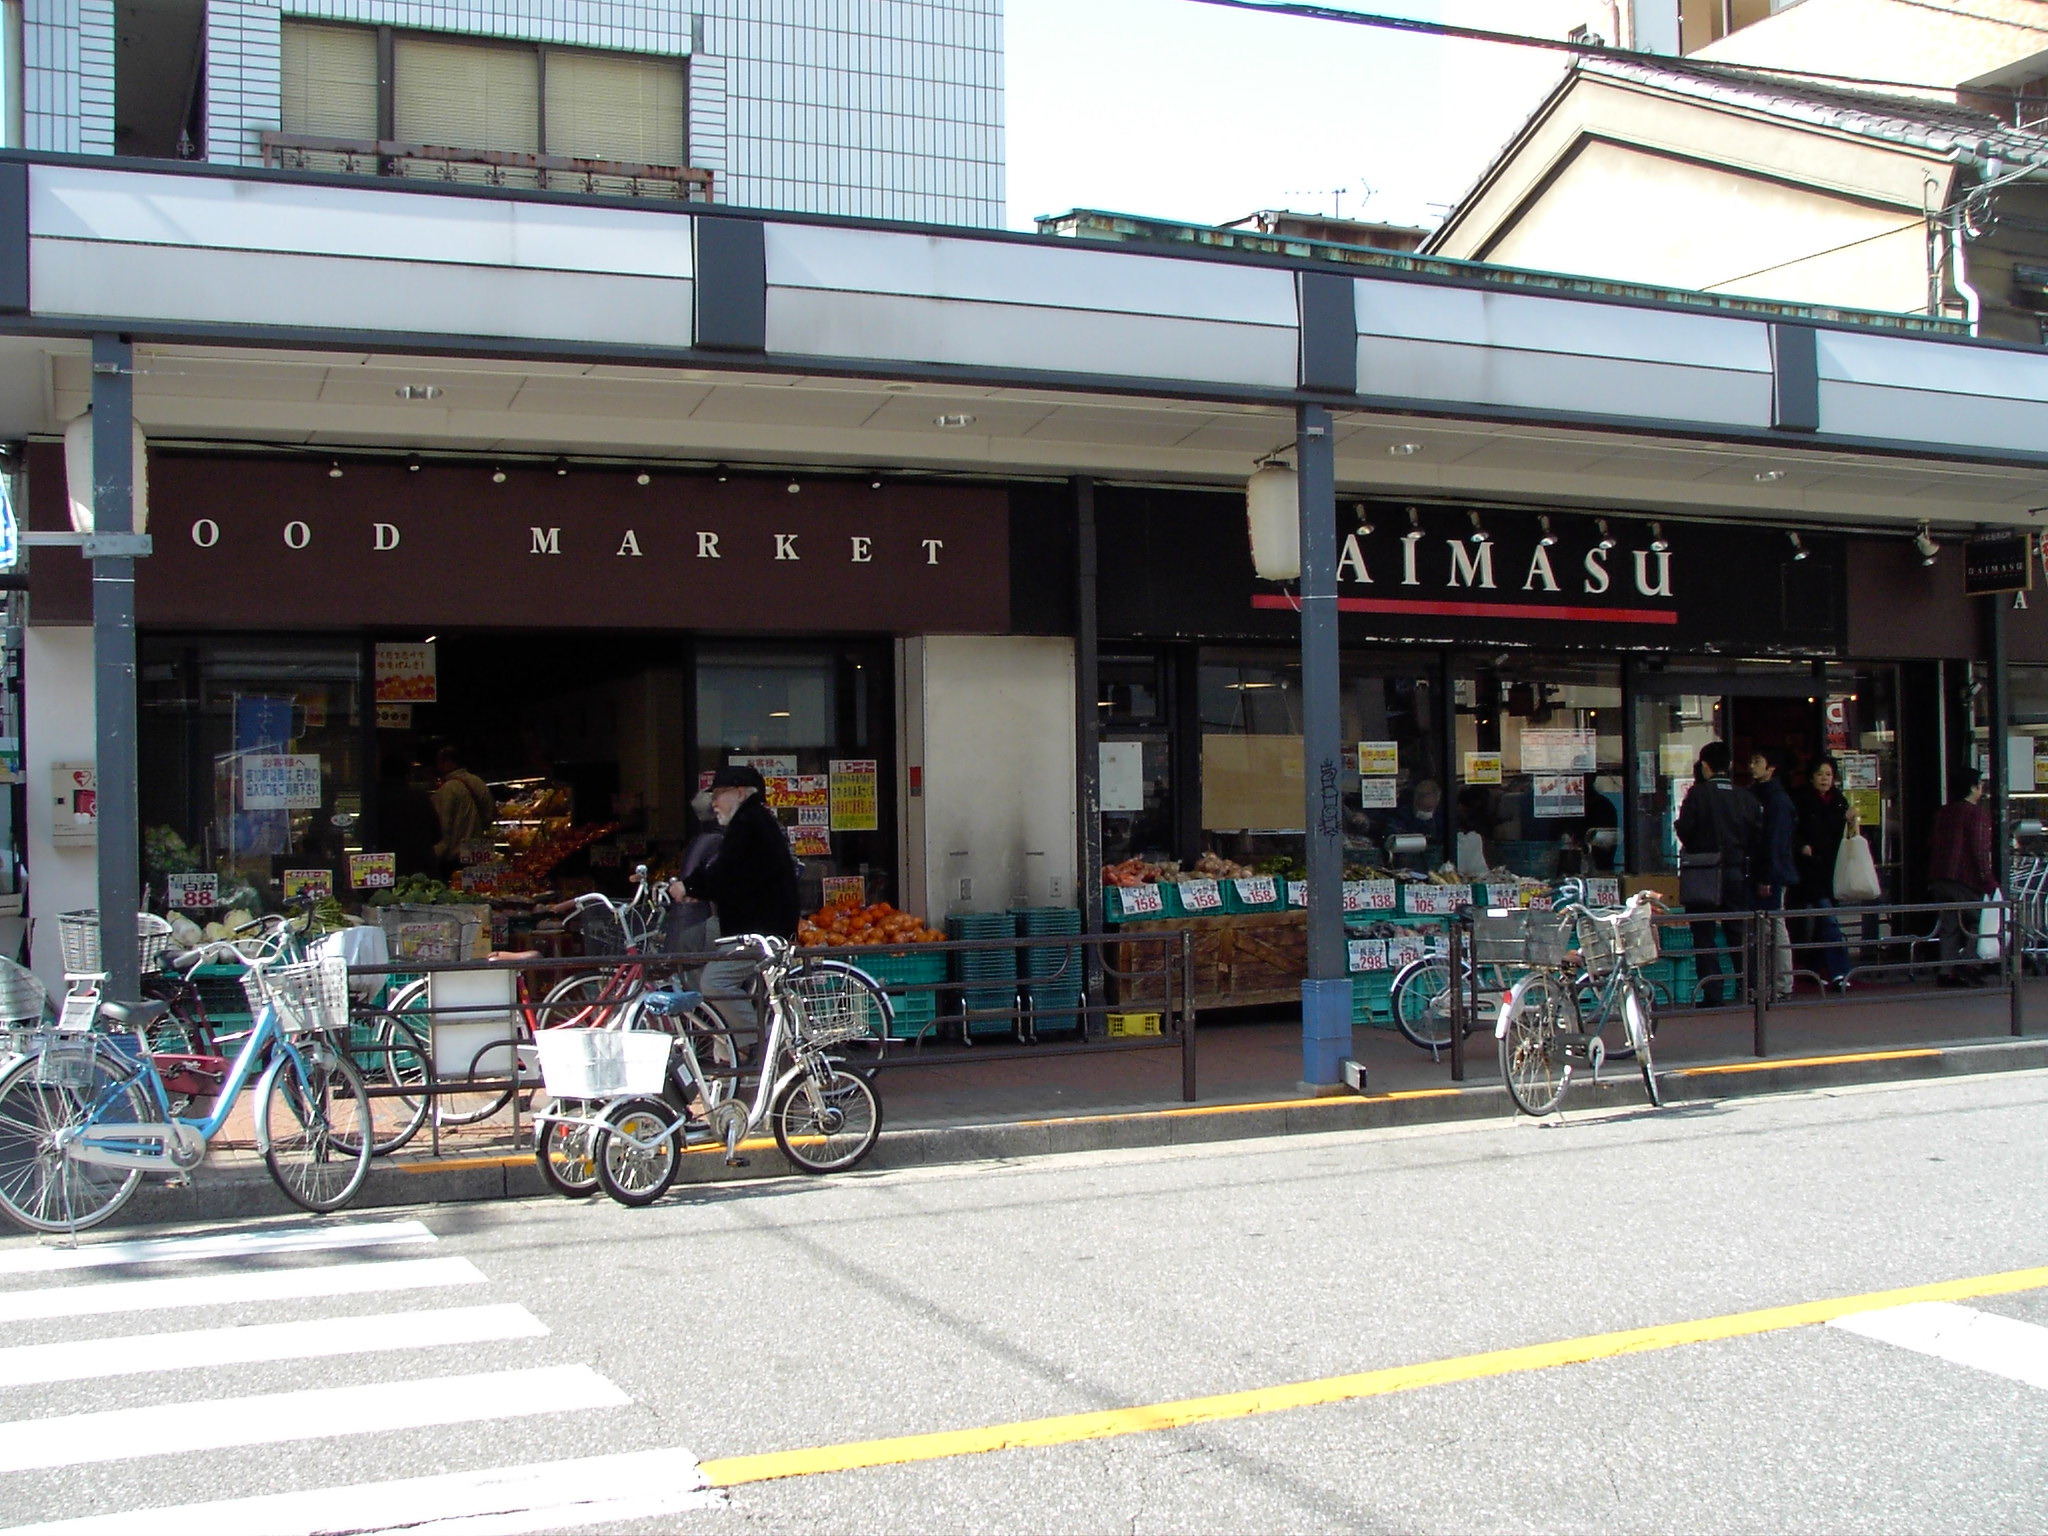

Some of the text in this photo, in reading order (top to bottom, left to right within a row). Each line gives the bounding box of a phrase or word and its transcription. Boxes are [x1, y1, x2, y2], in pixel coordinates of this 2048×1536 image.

[191, 519, 944, 565] OOD MARKET
[1337, 533, 1674, 597] AIMASU
[262, 758, 306, 768] お客様へ
[767, 793, 826, 806] イムサービス
[365, 873, 389, 886] 198
[184, 891, 212, 906] 88
[1193, 895, 1217, 907] 158
[1250, 890, 1272, 903] 158
[1343, 897, 1357, 909] 58
[1371, 895, 1392, 907] 138
[1135, 898, 1157, 910] 158
[1414, 900, 1434, 912] 105
[1360, 956, 1382, 969] 298
